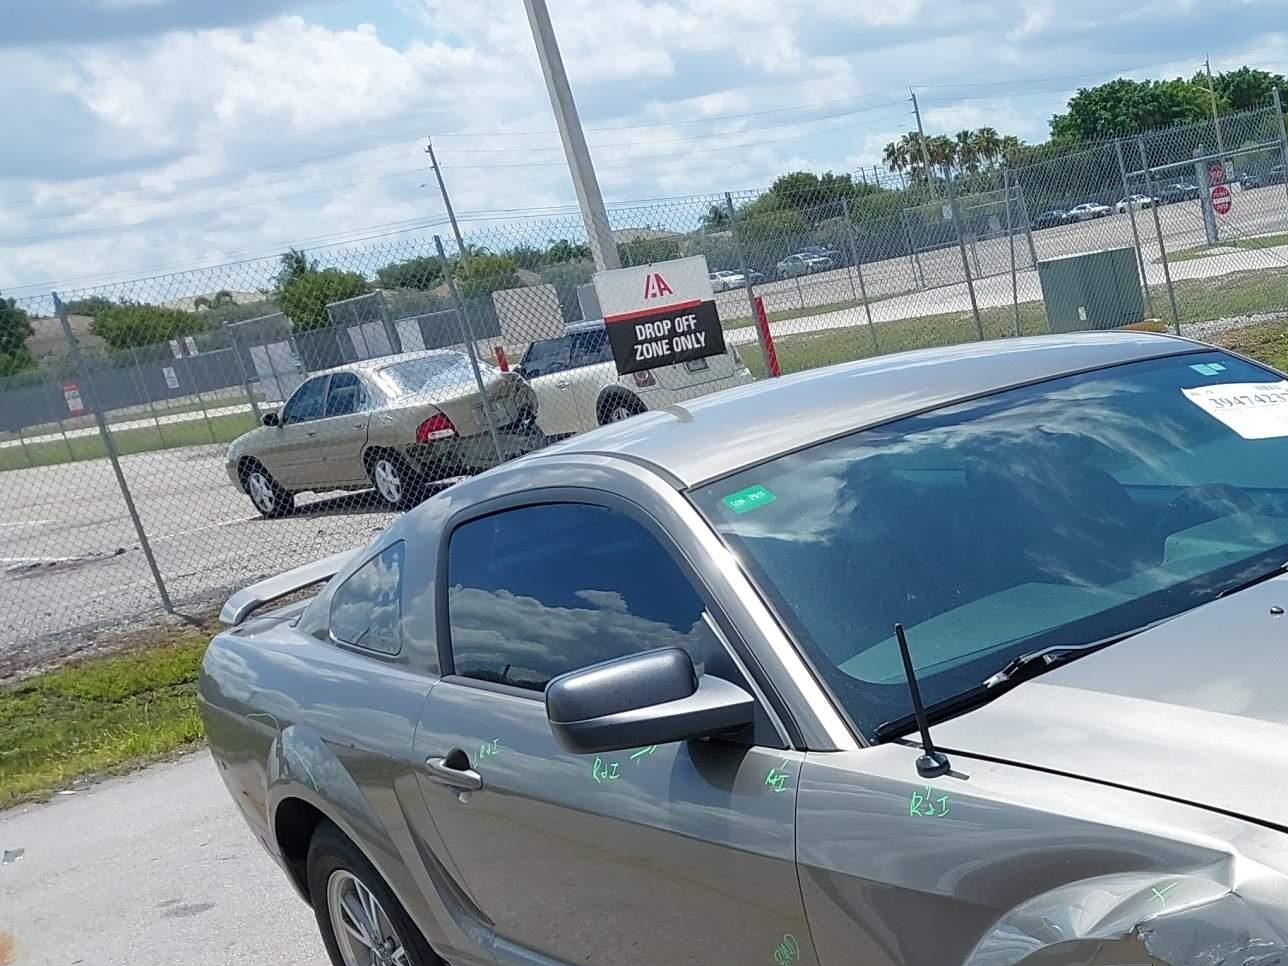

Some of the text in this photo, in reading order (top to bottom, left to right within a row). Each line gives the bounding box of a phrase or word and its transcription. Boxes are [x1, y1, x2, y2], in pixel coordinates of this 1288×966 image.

[635, 314, 697, 341] DROP OFF
[634, 331, 706, 361] ZONE ONLY
